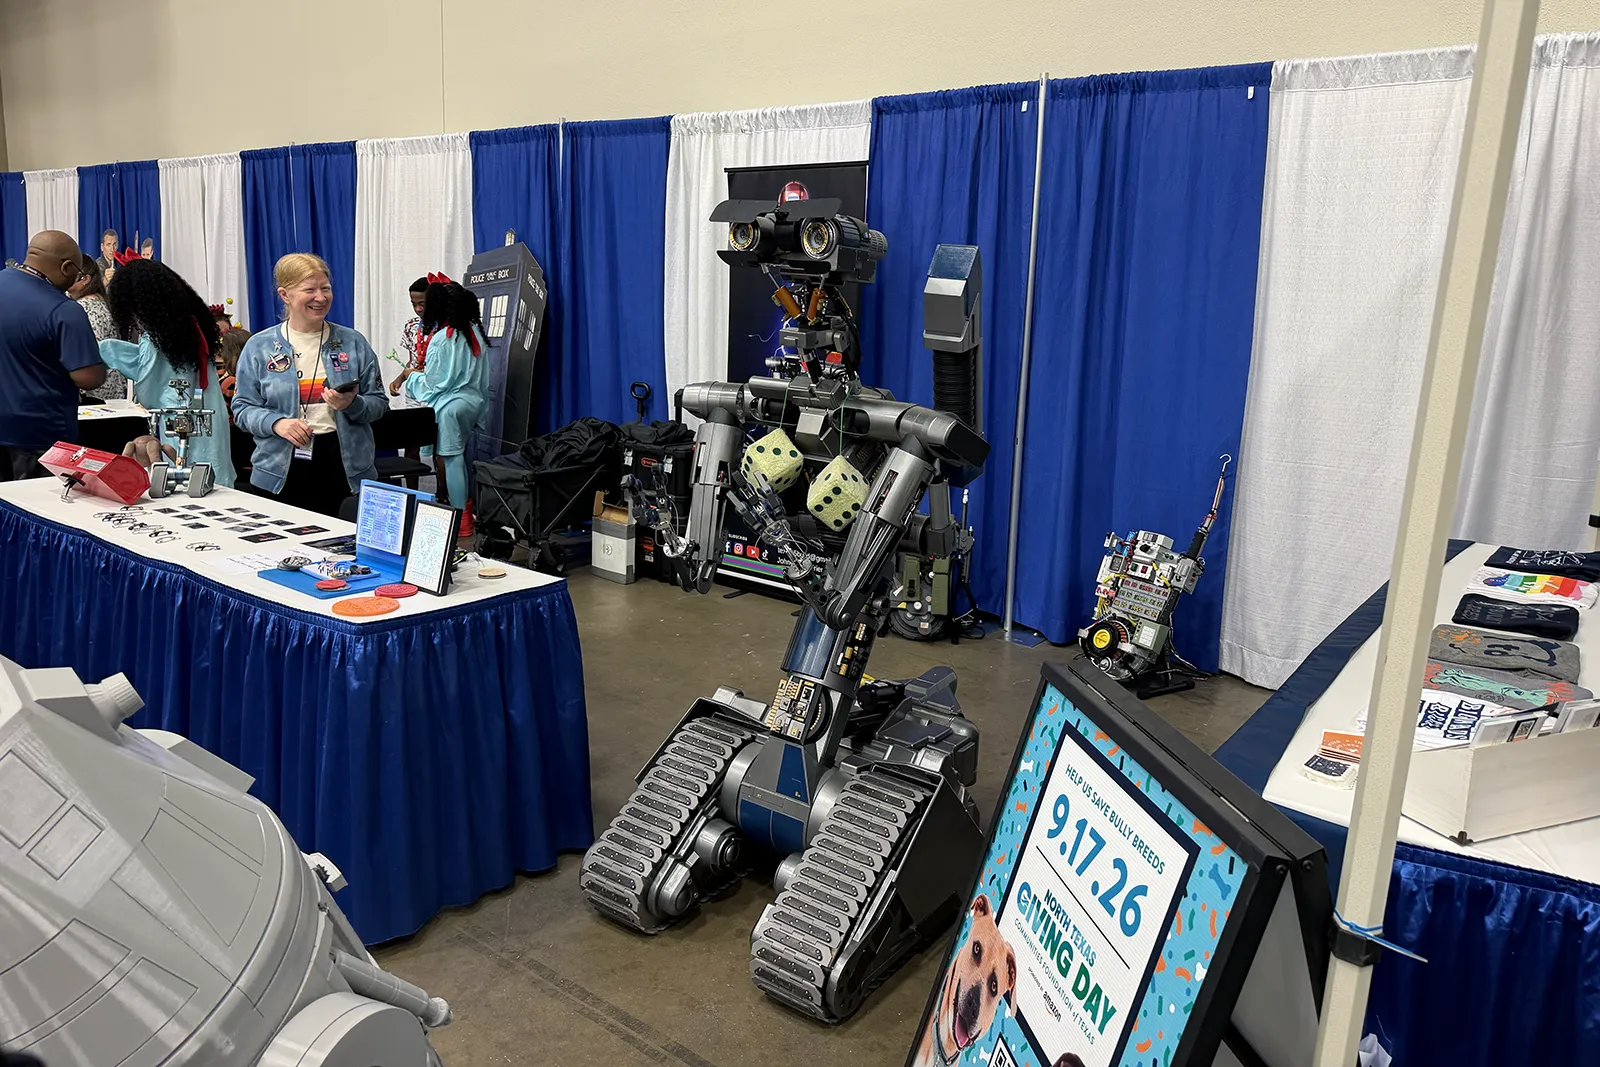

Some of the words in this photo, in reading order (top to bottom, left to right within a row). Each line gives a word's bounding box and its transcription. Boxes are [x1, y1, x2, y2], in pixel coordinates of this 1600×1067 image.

[470, 273, 485, 284] POLICE
[497, 269, 510, 279] BOX
[1065, 763, 1083, 787] HELP
[1082, 780, 1093, 799] US
[1090, 792, 1111, 818] SAVE
[1108, 810, 1134, 841] BULLY
[1131, 833, 1166, 875] BREEDS
[1016, 881, 1074, 979] GIVING
[1071, 962, 1118, 1036] DAY
[1044, 889, 1071, 932] NORTH
[1071, 925, 1097, 967] TEXAS
[1014, 918, 1043, 965] COMMUNITIES
[1042, 962, 1073, 1012] FOUNDATION
[1072, 1011, 1079, 1023] of
[1078, 1019, 1095, 1045] TEXAS
[1042, 990, 1063, 1024] amazon
